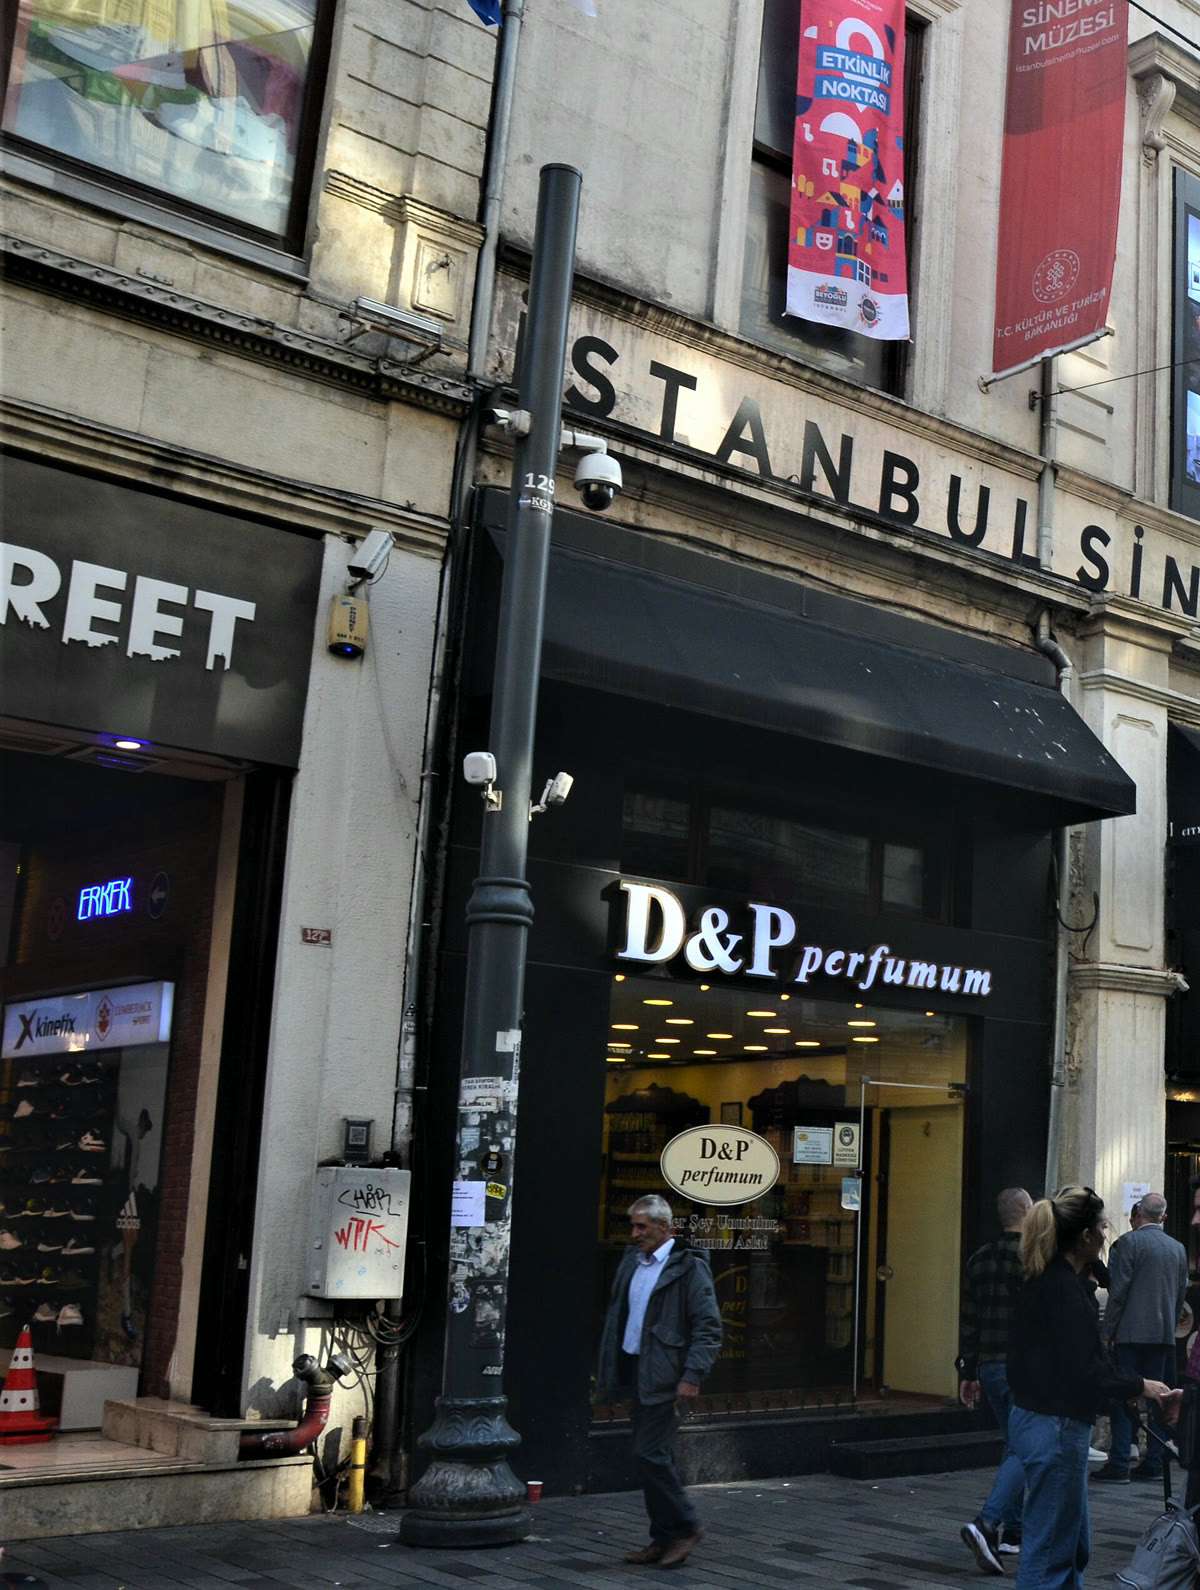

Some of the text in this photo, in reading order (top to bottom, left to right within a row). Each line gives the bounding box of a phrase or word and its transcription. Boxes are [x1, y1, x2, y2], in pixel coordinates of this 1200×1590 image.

[1021, 0, 1101, 27] SİNEM
[1023, 3, 1115, 55] MÜZESİ
[822, 51, 890, 85] ETKİNLİK
[822, 80, 887, 111] NOKTASI
[1015, 310, 1053, 332] KÜLTÜR
[1055, 304, 1069, 317] VE
[1024, 313, 1079, 341] BAKANLIĞI
[524, 472, 555, 495] 129
[78, 878, 131, 920] ERKEK
[617, 880, 993, 997] D&P perfumum
[35, 1013, 77, 1038] kinetix
[699, 1137, 750, 1161] D&P
[680, 1166, 763, 1187] perfumum
[689, 1214, 714, 1232] Şey
[734, 1235, 768, 1250] Asla!
